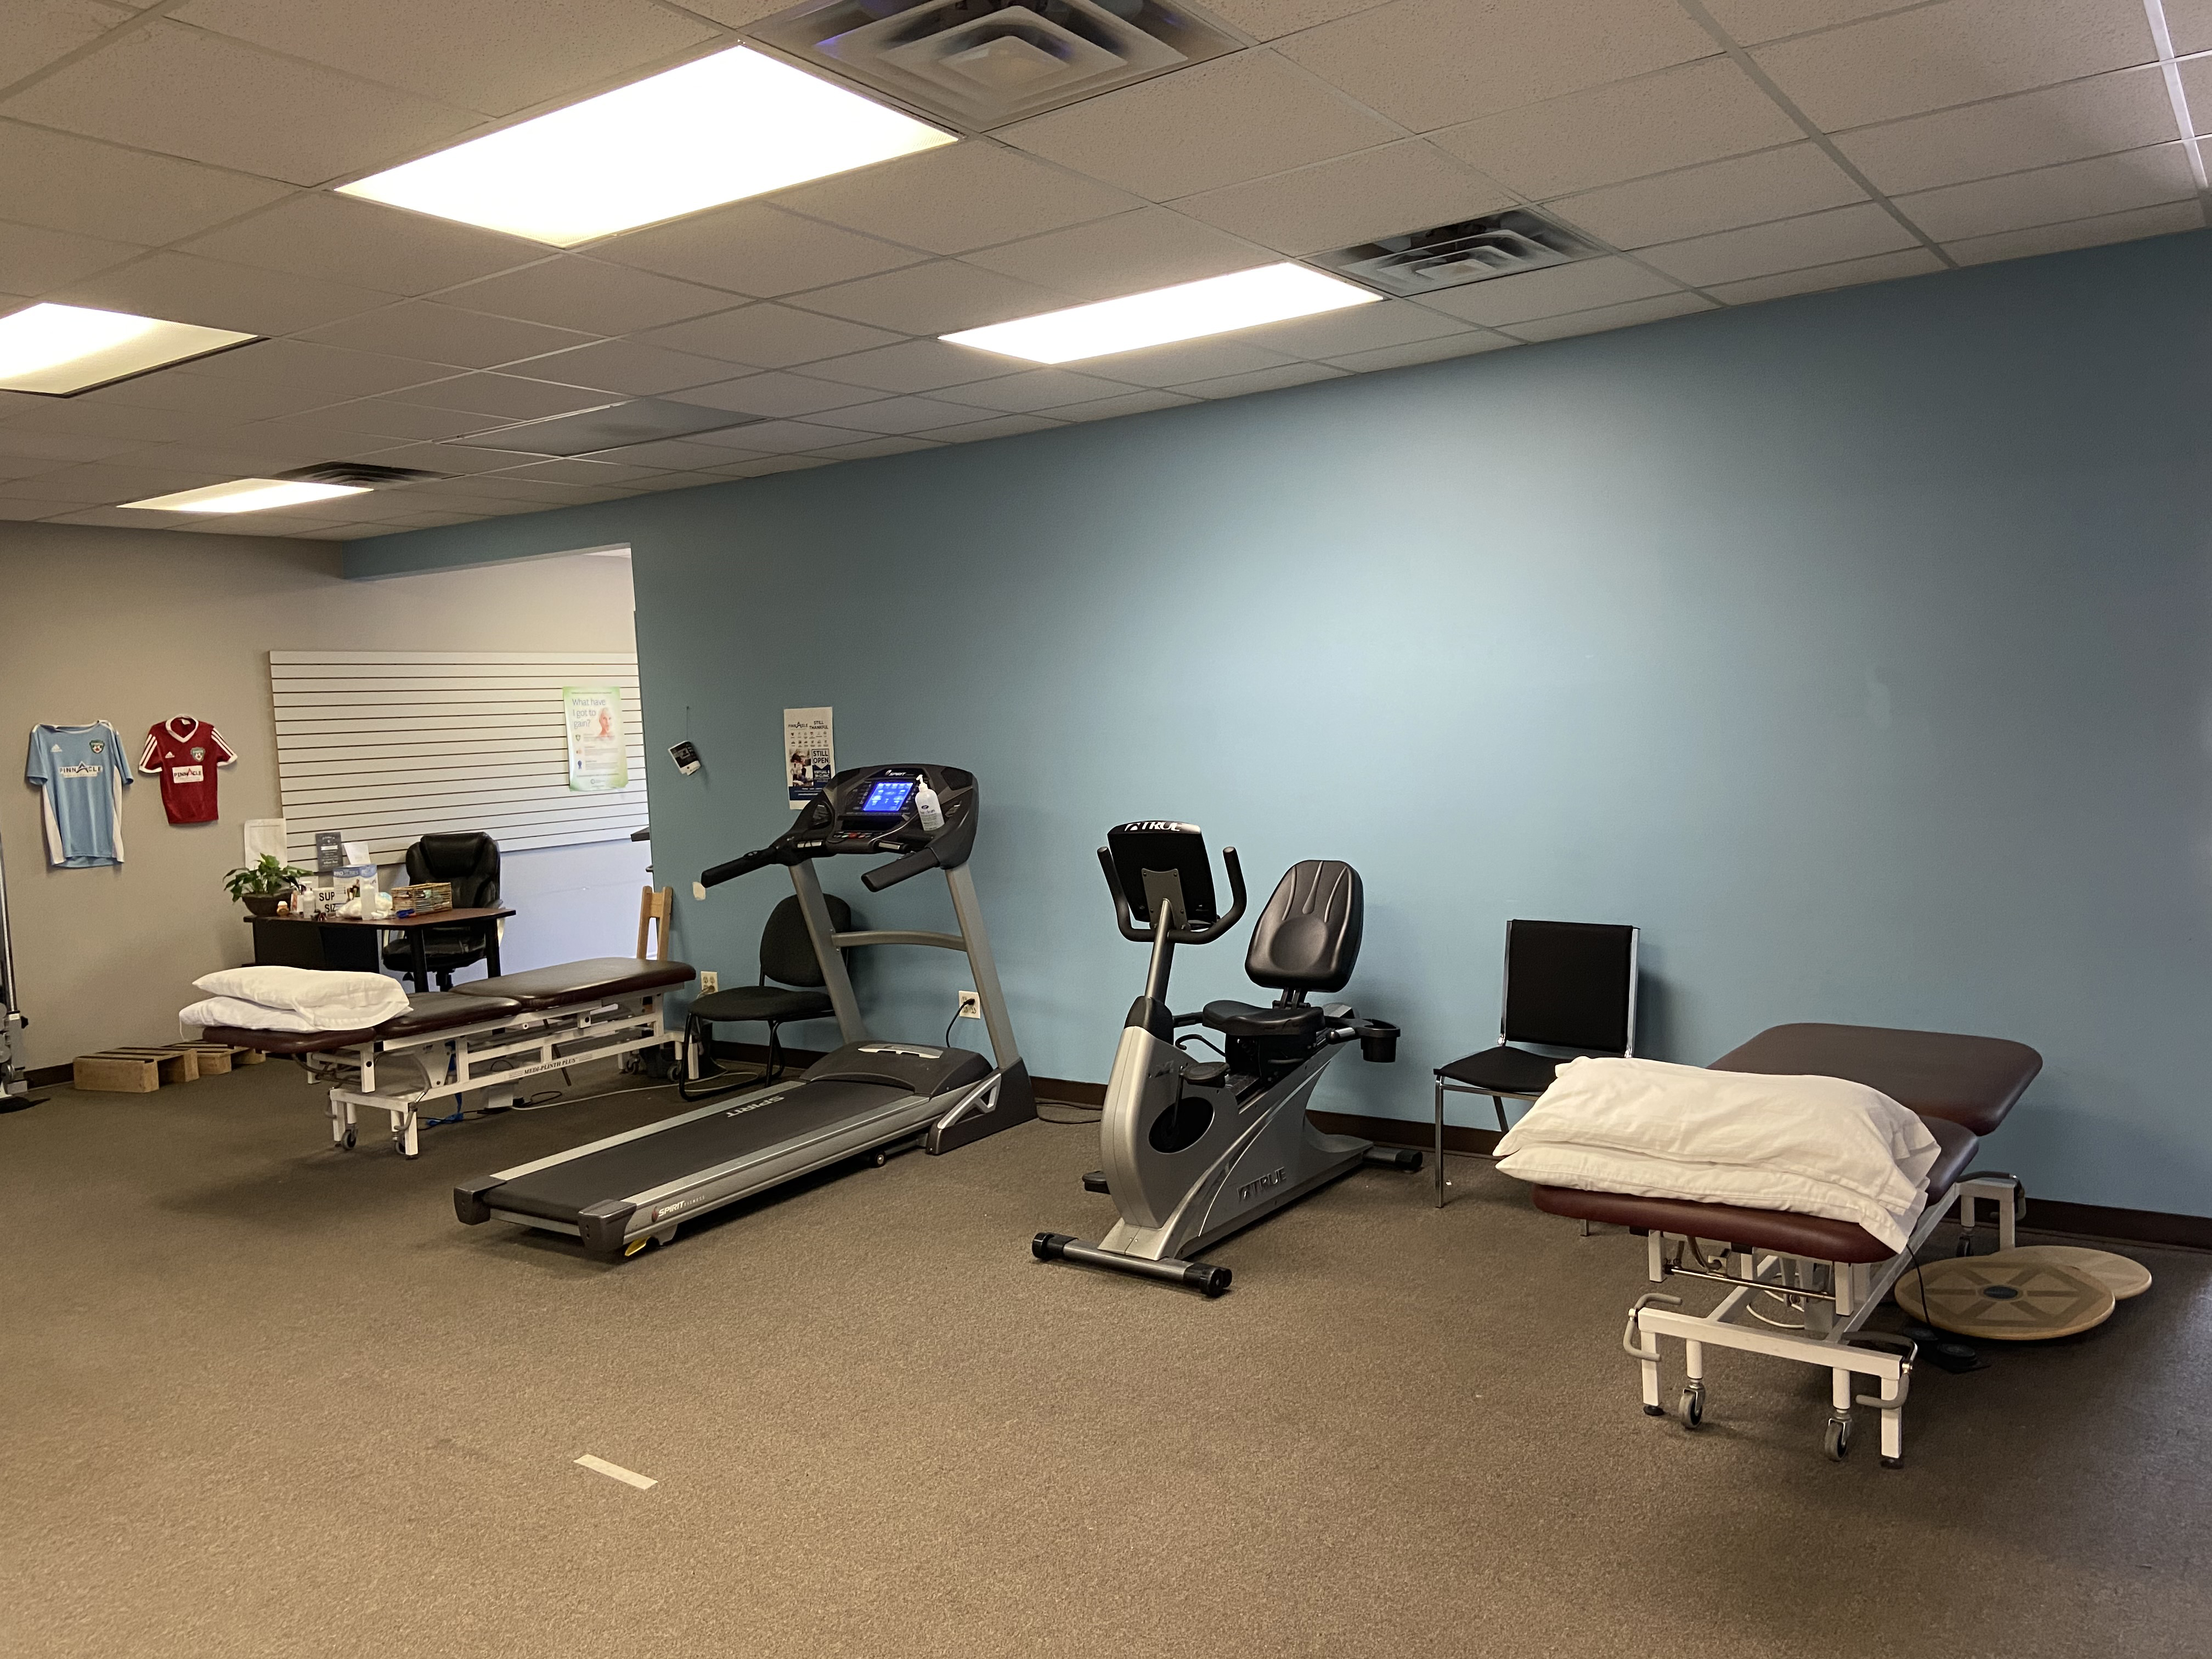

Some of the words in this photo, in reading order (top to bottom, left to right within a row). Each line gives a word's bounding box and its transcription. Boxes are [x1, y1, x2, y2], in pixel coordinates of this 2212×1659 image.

[577, 710, 588, 719] got
[574, 719, 591, 729] gain?
[59, 762, 102, 774] PINNACLE
[174, 768, 201, 777] PINNACLE
[1142, 821, 1182, 832] TRUE
[524, 1061, 561, 1074] MEDI-PLINTH
[726, 1096, 785, 1118] SPIRIT
[1250, 1166, 1286, 1194] TRUE
[658, 1200, 685, 1217] SPIRIT
